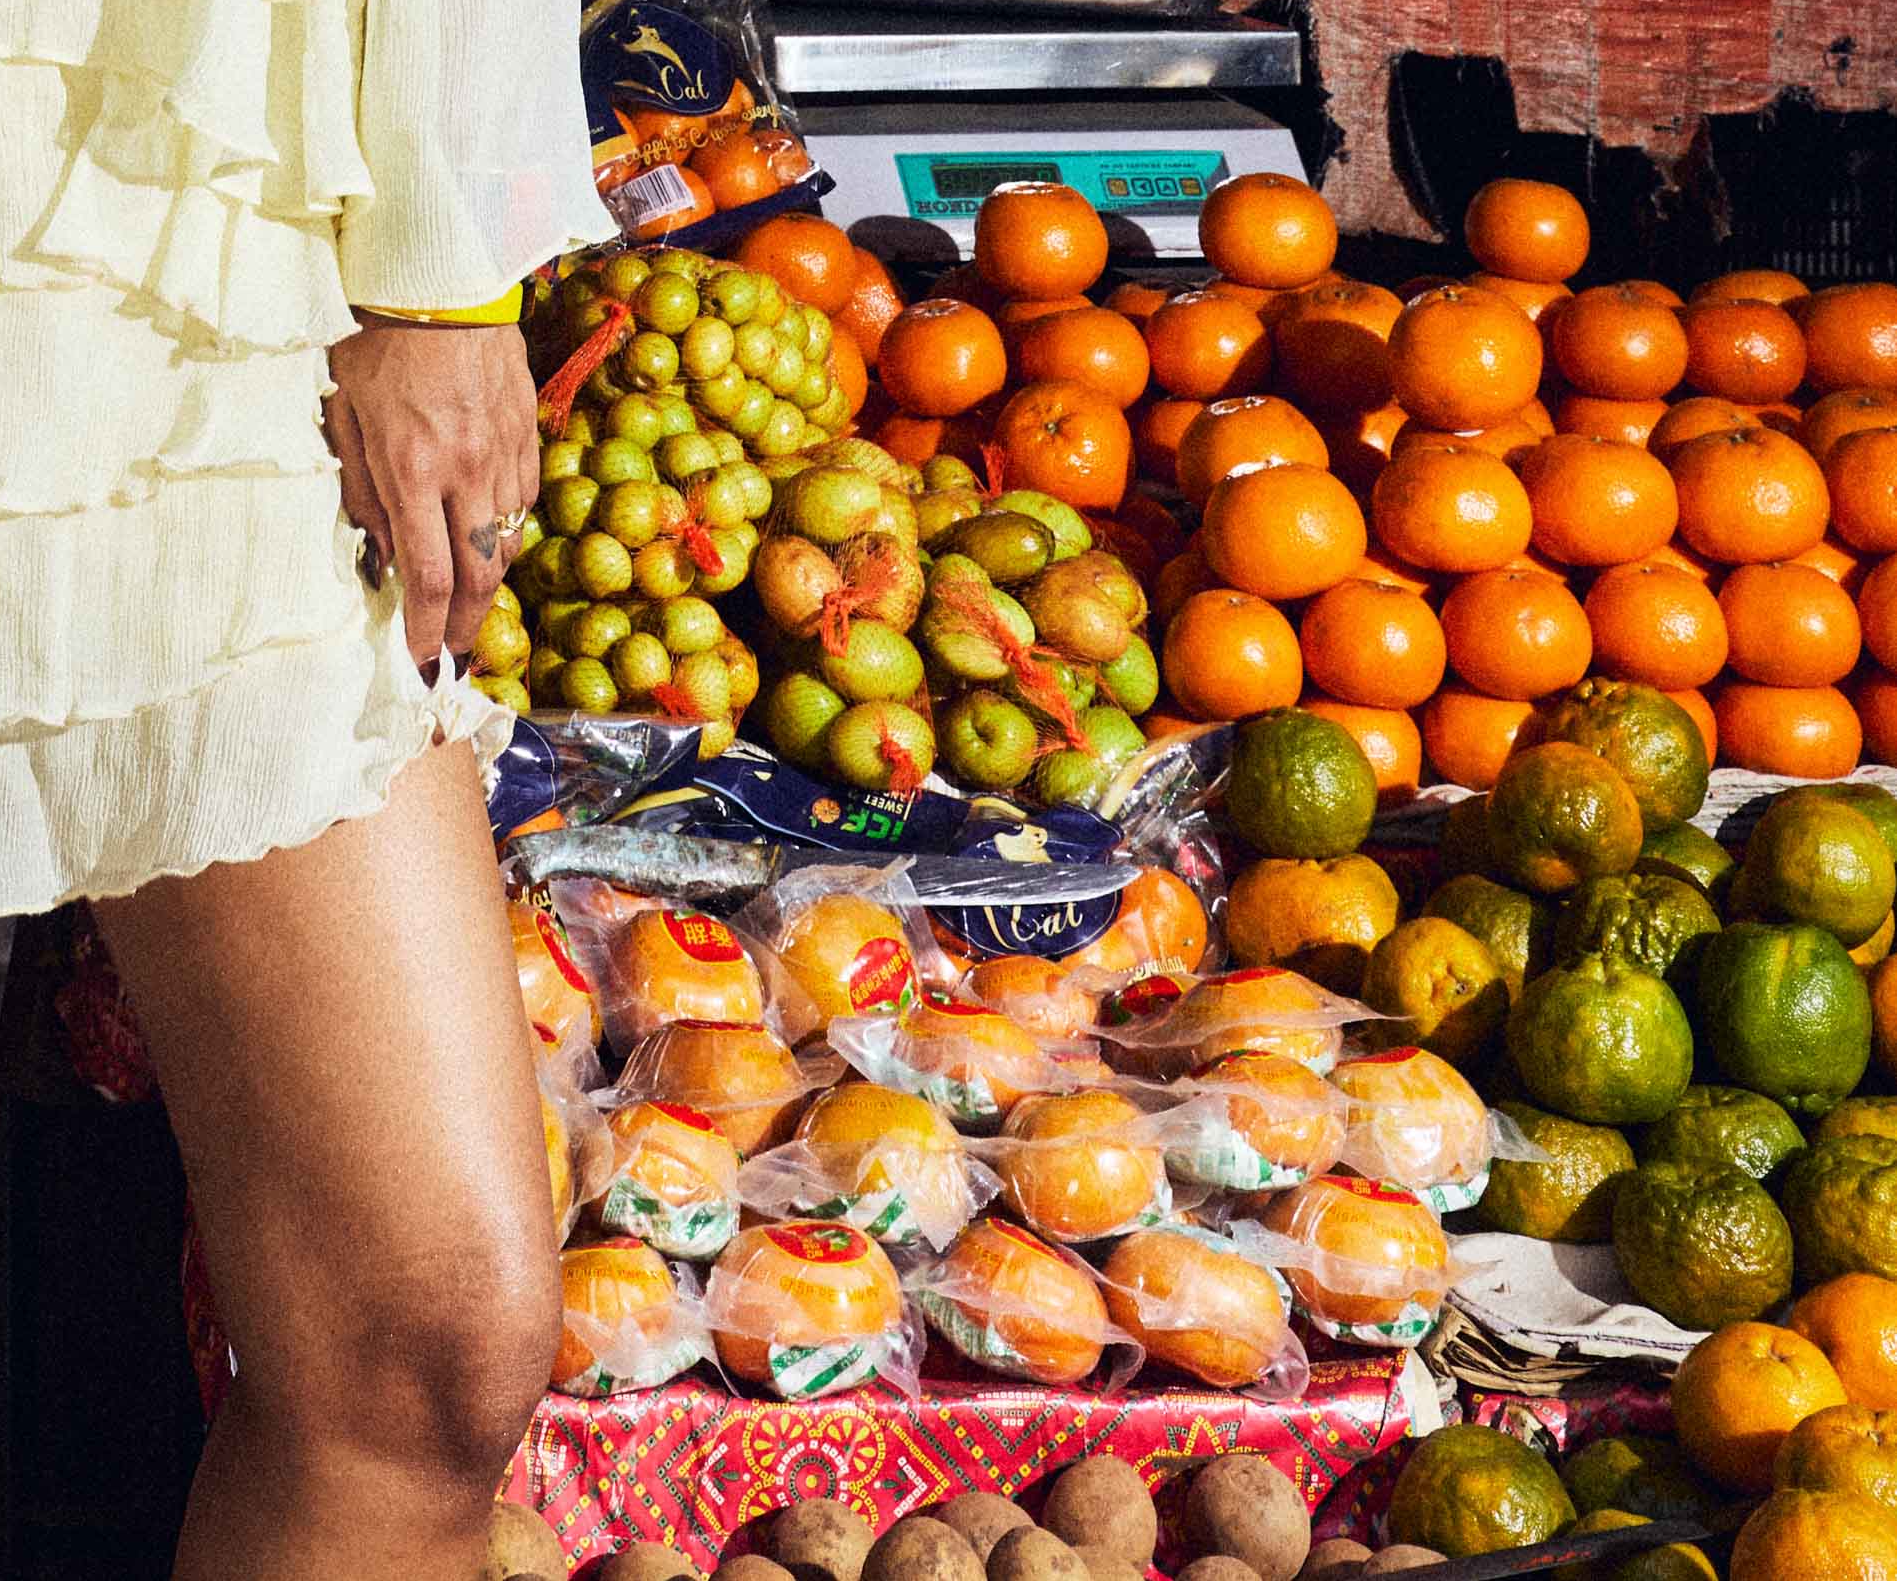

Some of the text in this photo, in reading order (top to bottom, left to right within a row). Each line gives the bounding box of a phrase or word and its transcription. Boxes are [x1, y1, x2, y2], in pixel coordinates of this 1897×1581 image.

[660, 64, 710, 101] Cat
[914, 199, 978, 216] HOND
[862, 793, 904, 815] SWEET
